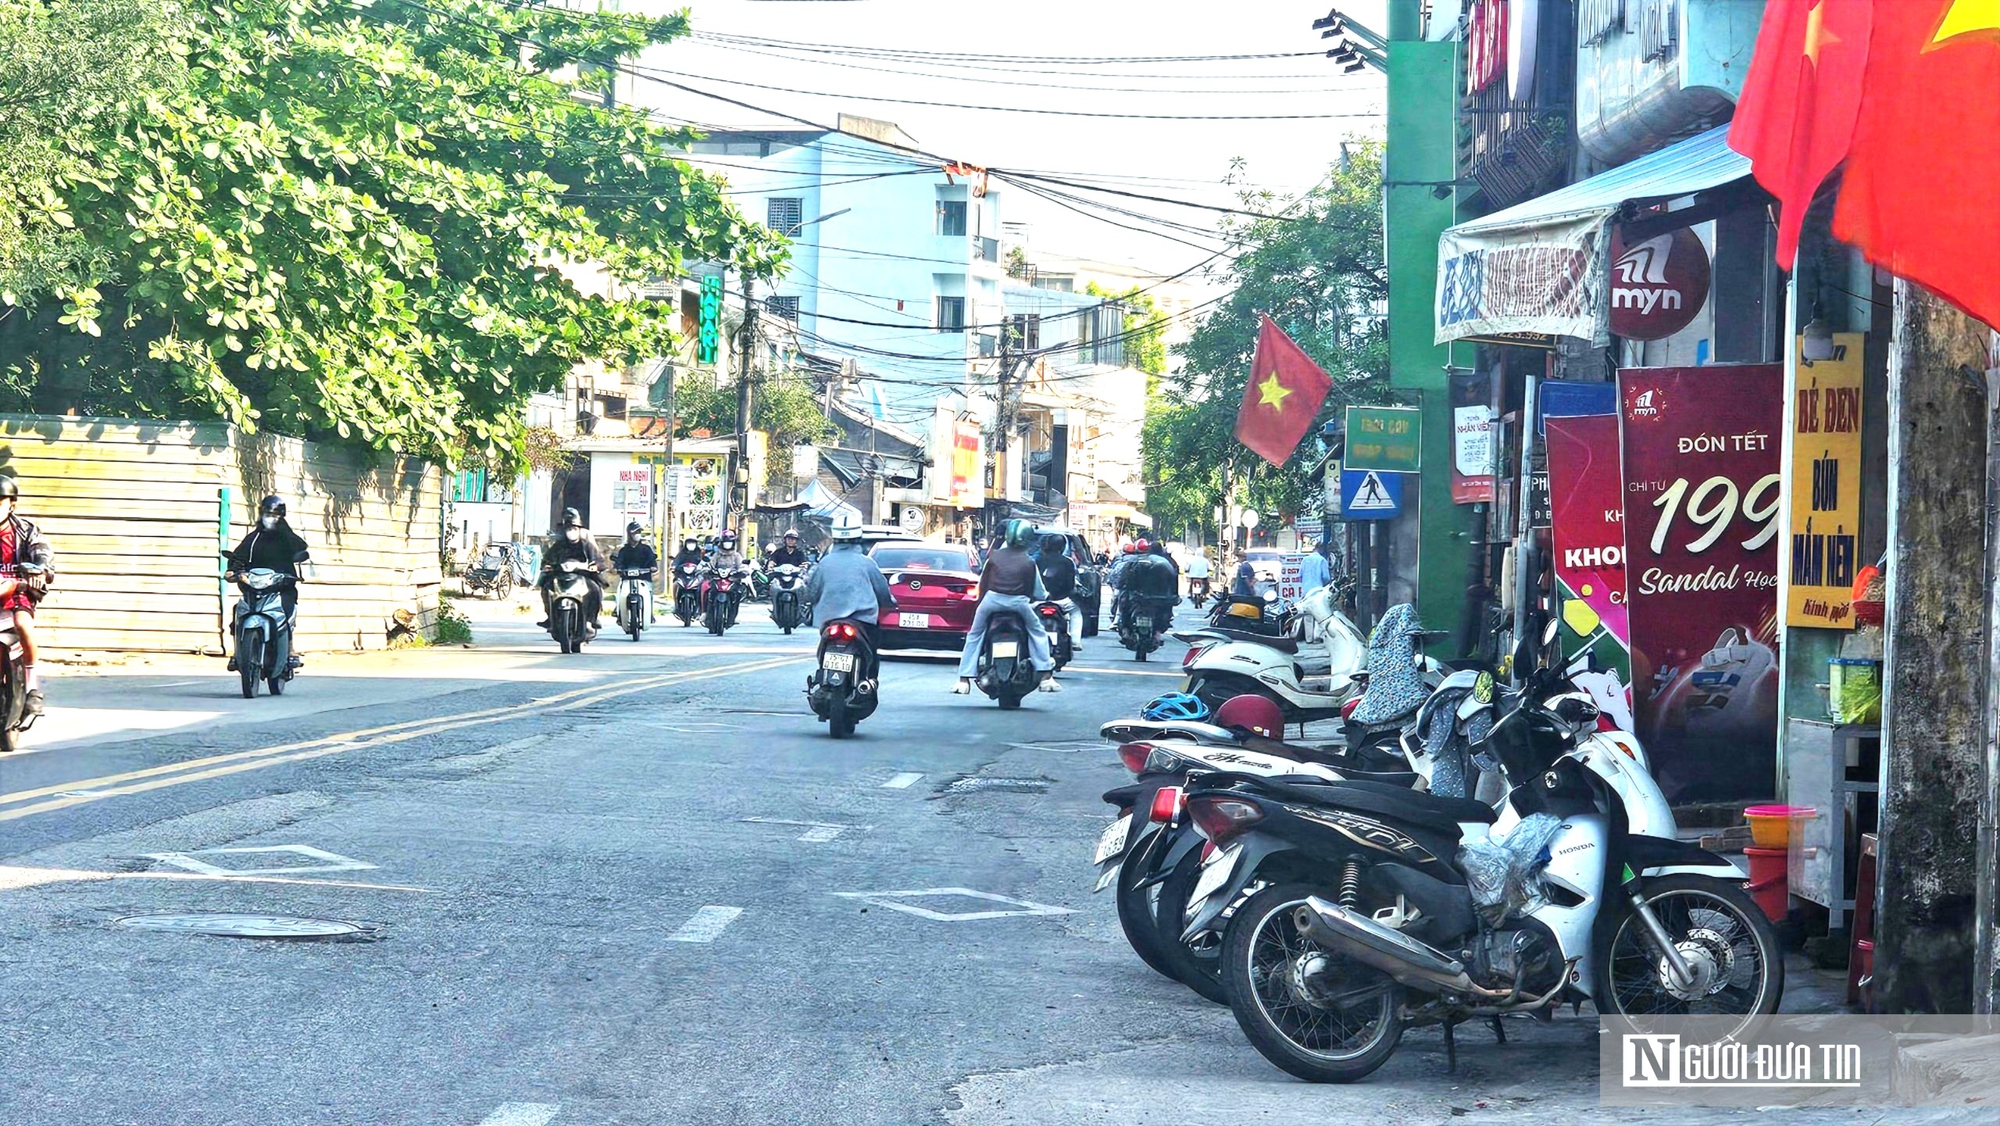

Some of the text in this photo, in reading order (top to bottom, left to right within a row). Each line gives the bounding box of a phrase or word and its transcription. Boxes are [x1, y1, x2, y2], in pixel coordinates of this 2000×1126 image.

[1612, 287, 1682, 315] myn
[1634, 407, 1657, 417] myn
[1677, 429, 1769, 453] ĐÓN TẾT
[1812, 450, 1839, 511] BÚN
[1652, 473, 1781, 555] 199
[1638, 564, 1740, 595] Sandal
[1559, 842, 1595, 855] HONDA
